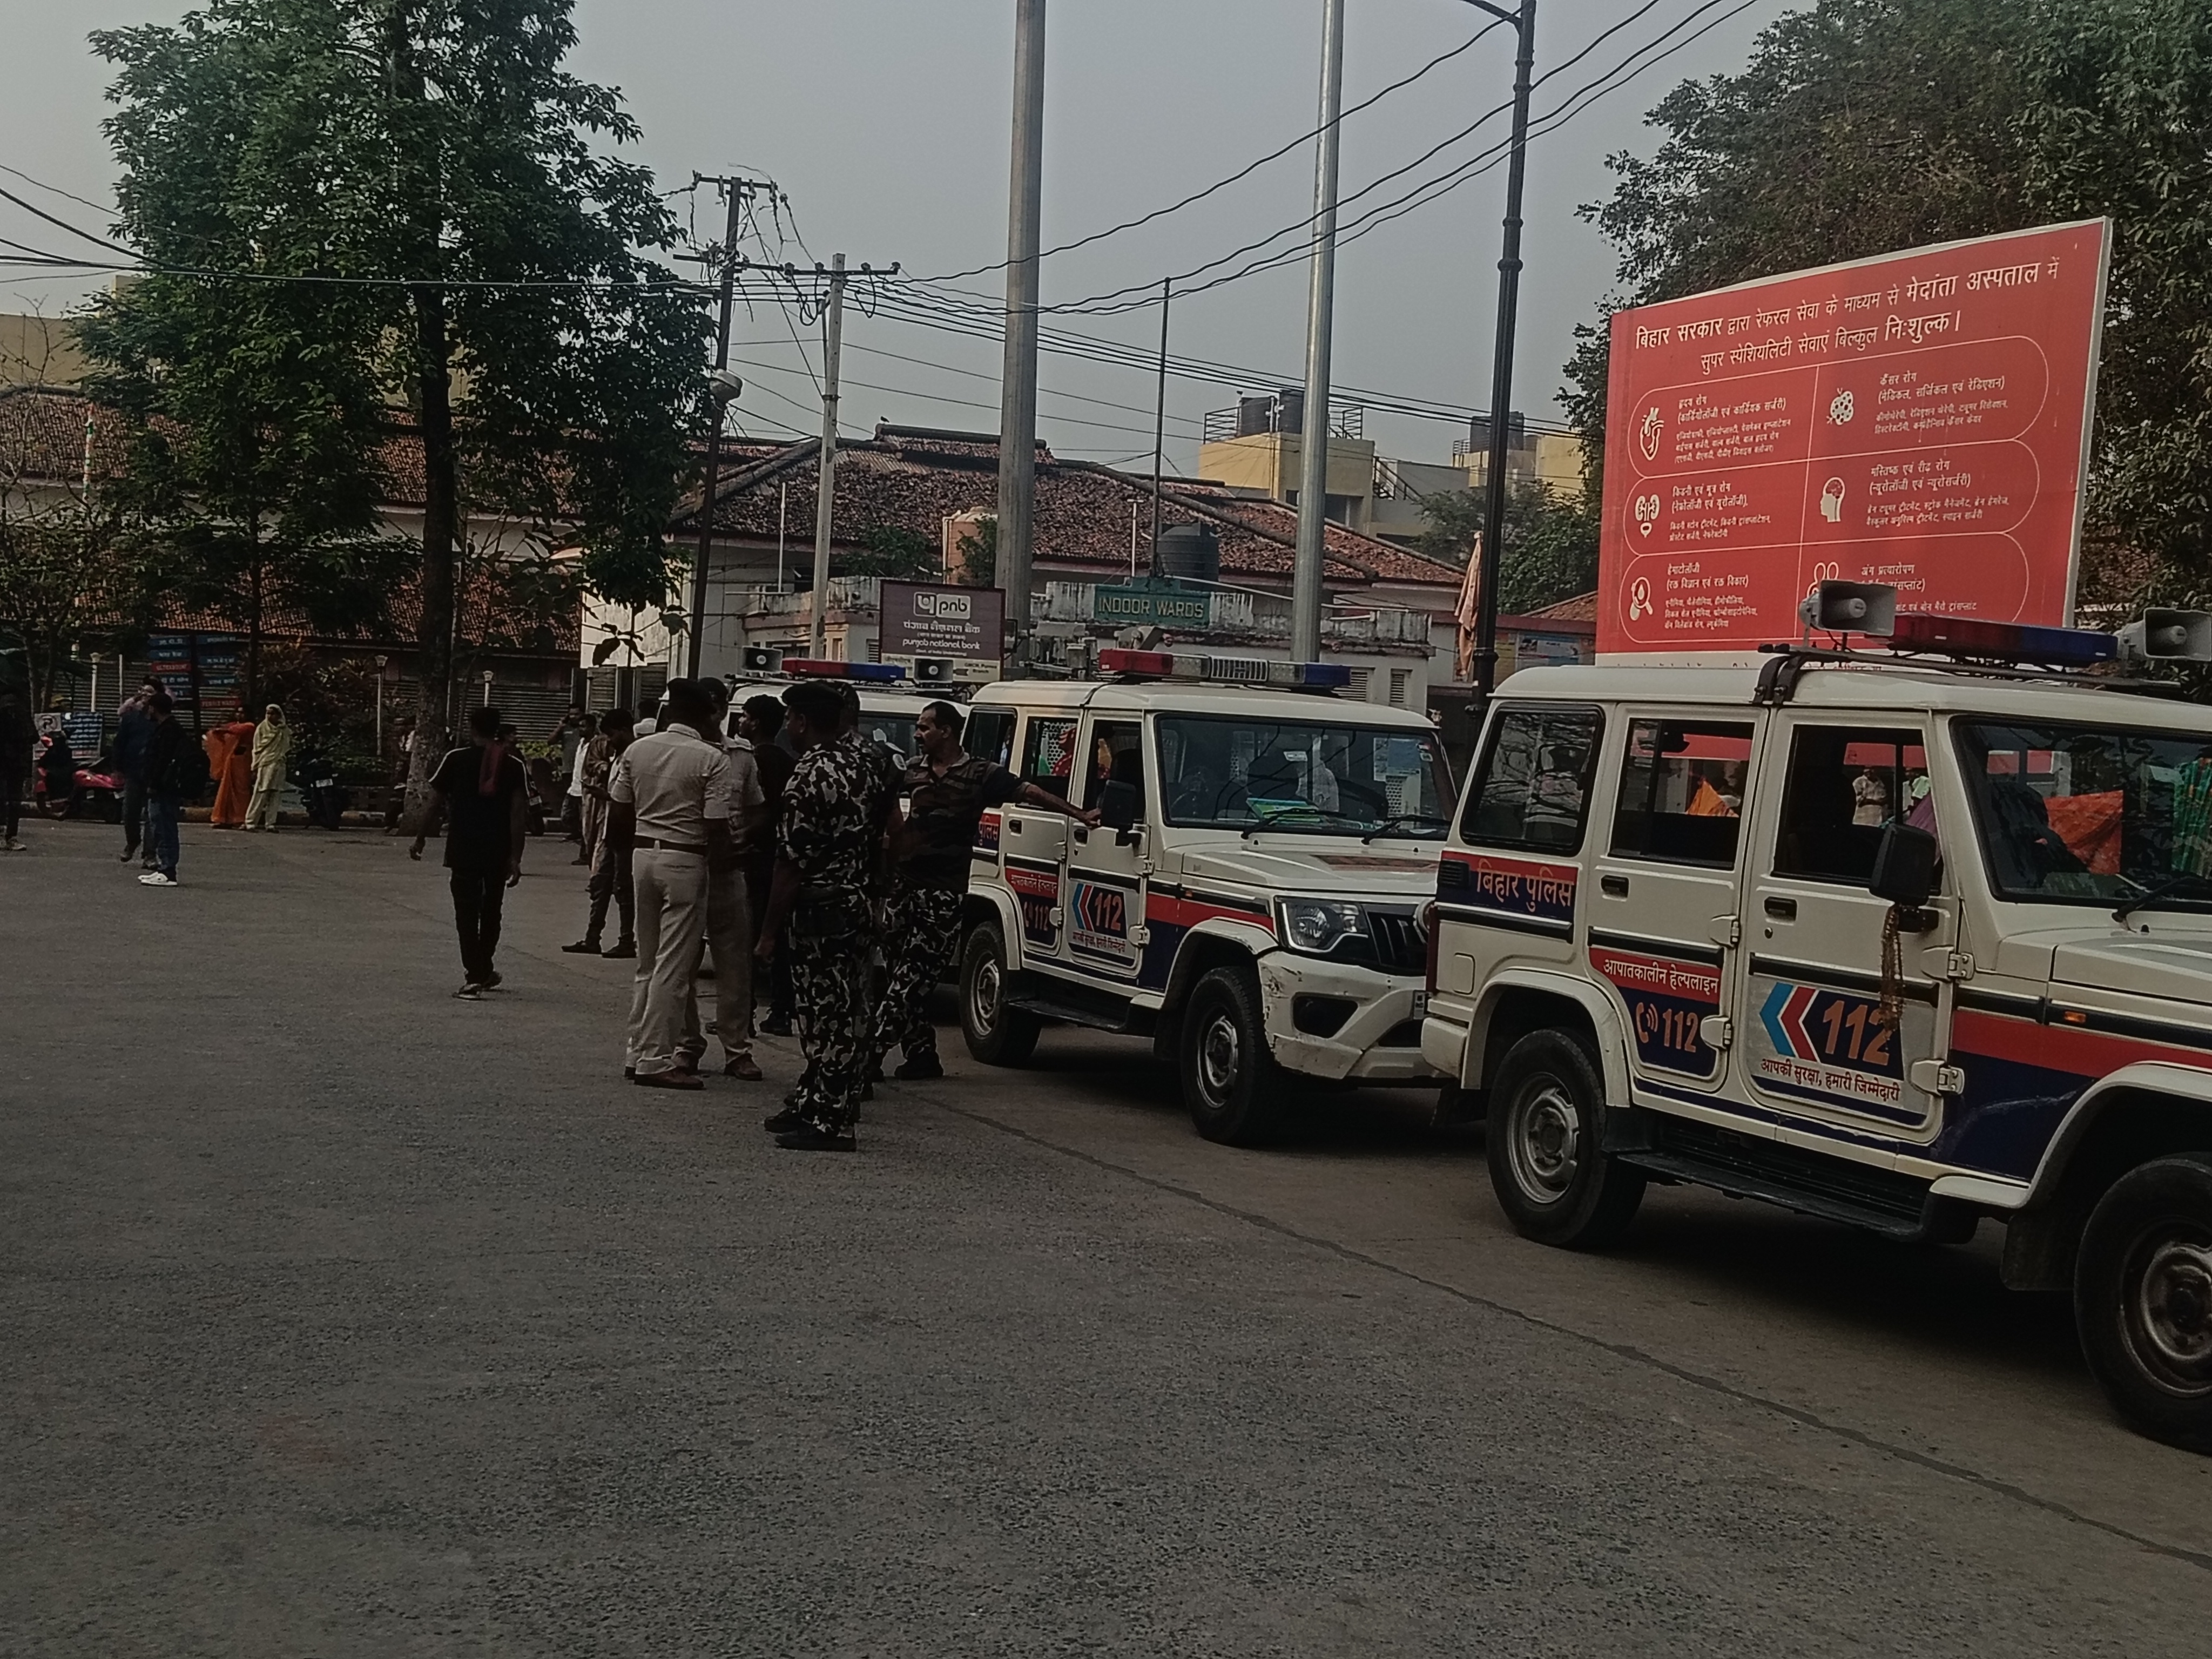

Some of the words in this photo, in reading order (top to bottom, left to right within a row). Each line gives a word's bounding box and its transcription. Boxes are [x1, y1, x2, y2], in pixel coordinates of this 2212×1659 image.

[1636, 326, 1671, 349] बिहार
[1677, 318, 1723, 342] सरकार
[1728, 315, 1751, 335] द्वारा
[1756, 308, 1791, 328] रेफरल
[1796, 298, 1820, 321] सेवा
[1826, 294, 1838, 315] के
[1844, 292, 1881, 313] माध्यम
[1887, 284, 1900, 306] से
[1906, 273, 1959, 302] मेदांता
[1967, 262, 2041, 291] अस्पताल
[2047, 257, 2060, 279] में
[1701, 352, 1725, 375] सुपर
[1730, 336, 1792, 365] स्पेशियलिटी
[1798, 330, 1830, 353] सेवाएं
[1835, 326, 1878, 351] बिल्कुल
[1880, 374, 1899, 386] कैंसर
[1903, 370, 1917, 382] रोग
[1916, 382, 1947, 397] सर्जिकल
[1952, 380, 1964, 394] एवं
[1968, 376, 2005, 390] रेडिएशन)
[1696, 394, 1707, 404] रोग
[1678, 407, 1718, 424] (कार्डियोलॉजी
[1722, 405, 1730, 417] एवं
[1734, 401, 1761, 414] कार्डियक
[1764, 397, 1786, 411] सर्जरी)
[1871, 464, 1899, 477] मस्तिष्क
[1903, 461, 1914, 475] एवं
[1936, 458, 1950, 471] रोग
[1673, 484, 1691, 497] किडनी
[1695, 483, 1704, 496] एवं
[1707, 484, 1717, 497] मूत्र
[1719, 481, 1730, 493] रोग
[1870, 477, 1908, 495] (न्यूरोलॉजी
[1912, 476, 1924, 491] एवं
[1927, 473, 1971, 491] न्यूरोसर्जरी)
[1705, 497, 1714, 510] एवं
[1862, 564, 1874, 576] अंग
[1878, 562, 1915, 576] प्रत्यारोपण
[1702, 576, 1711, 589] एवं
[1727, 575, 1749, 588] विकार)
[939, 598, 967, 614] pnb
[1098, 597, 1150, 614] INDOOR
[1157, 601, 1204, 618] WARDS
[903, 619, 929, 630] पंजाब
[902, 638, 929, 648] punjab
[929, 639, 961, 649] national
[961, 642, 980, 650] bank
[978, 815, 999, 846] पुलिस
[1476, 858, 1521, 902] बिहार
[1526, 866, 1574, 912] पुलिस
[1035, 904, 1049, 932] 112
[1094, 892, 1122, 931] 112
[1603, 959, 1668, 984] आपातकालीन
[1669, 964, 1719, 995] हेल्पलाइन
[1663, 1008, 1698, 1053] 112
[1823, 1000, 1892, 1066] 112
[1761, 1058, 1792, 1077] आपकी
[1795, 1064, 1822, 1086] सुरक्षा,
[1825, 1071, 1852, 1090] हमारी
[1854, 1073, 1900, 1101] जिम्मेदारी
